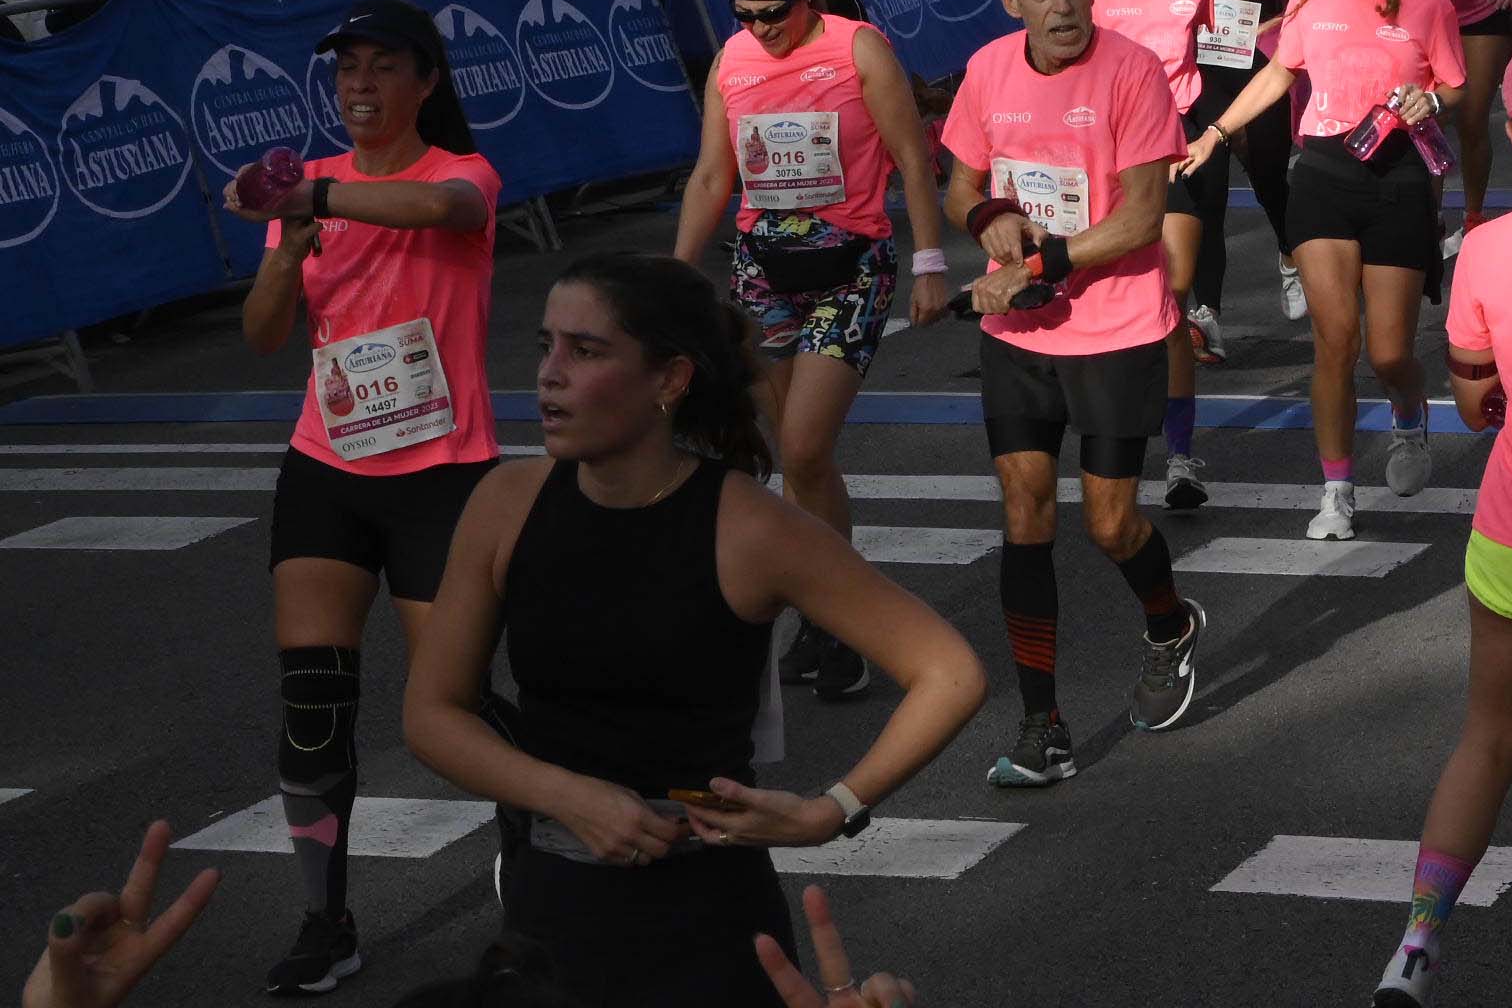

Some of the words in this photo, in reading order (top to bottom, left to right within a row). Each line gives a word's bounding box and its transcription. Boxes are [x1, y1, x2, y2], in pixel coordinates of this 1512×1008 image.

[524, 40, 610, 85] ASTURIANA
[729, 74, 767, 86] OYSHO
[202, 101, 307, 154] ASTURIANA
[768, 130, 804, 139] ASTURIANA
[772, 151, 805, 164] 016
[775, 169, 802, 178] 30736
[1021, 177, 1056, 190] ASTURIANA
[1022, 201, 1055, 218] 016
[320, 220, 348, 233] SHO
[349, 352, 392, 369] ASTURIANA
[356, 376, 398, 400] 016
[365, 398, 397, 415] 14497
[340, 422, 371, 434] CARRERA
[394, 408, 419, 421] MUJER
[342, 436, 376, 452] OYSHO
[406, 417, 446, 435] Santander
